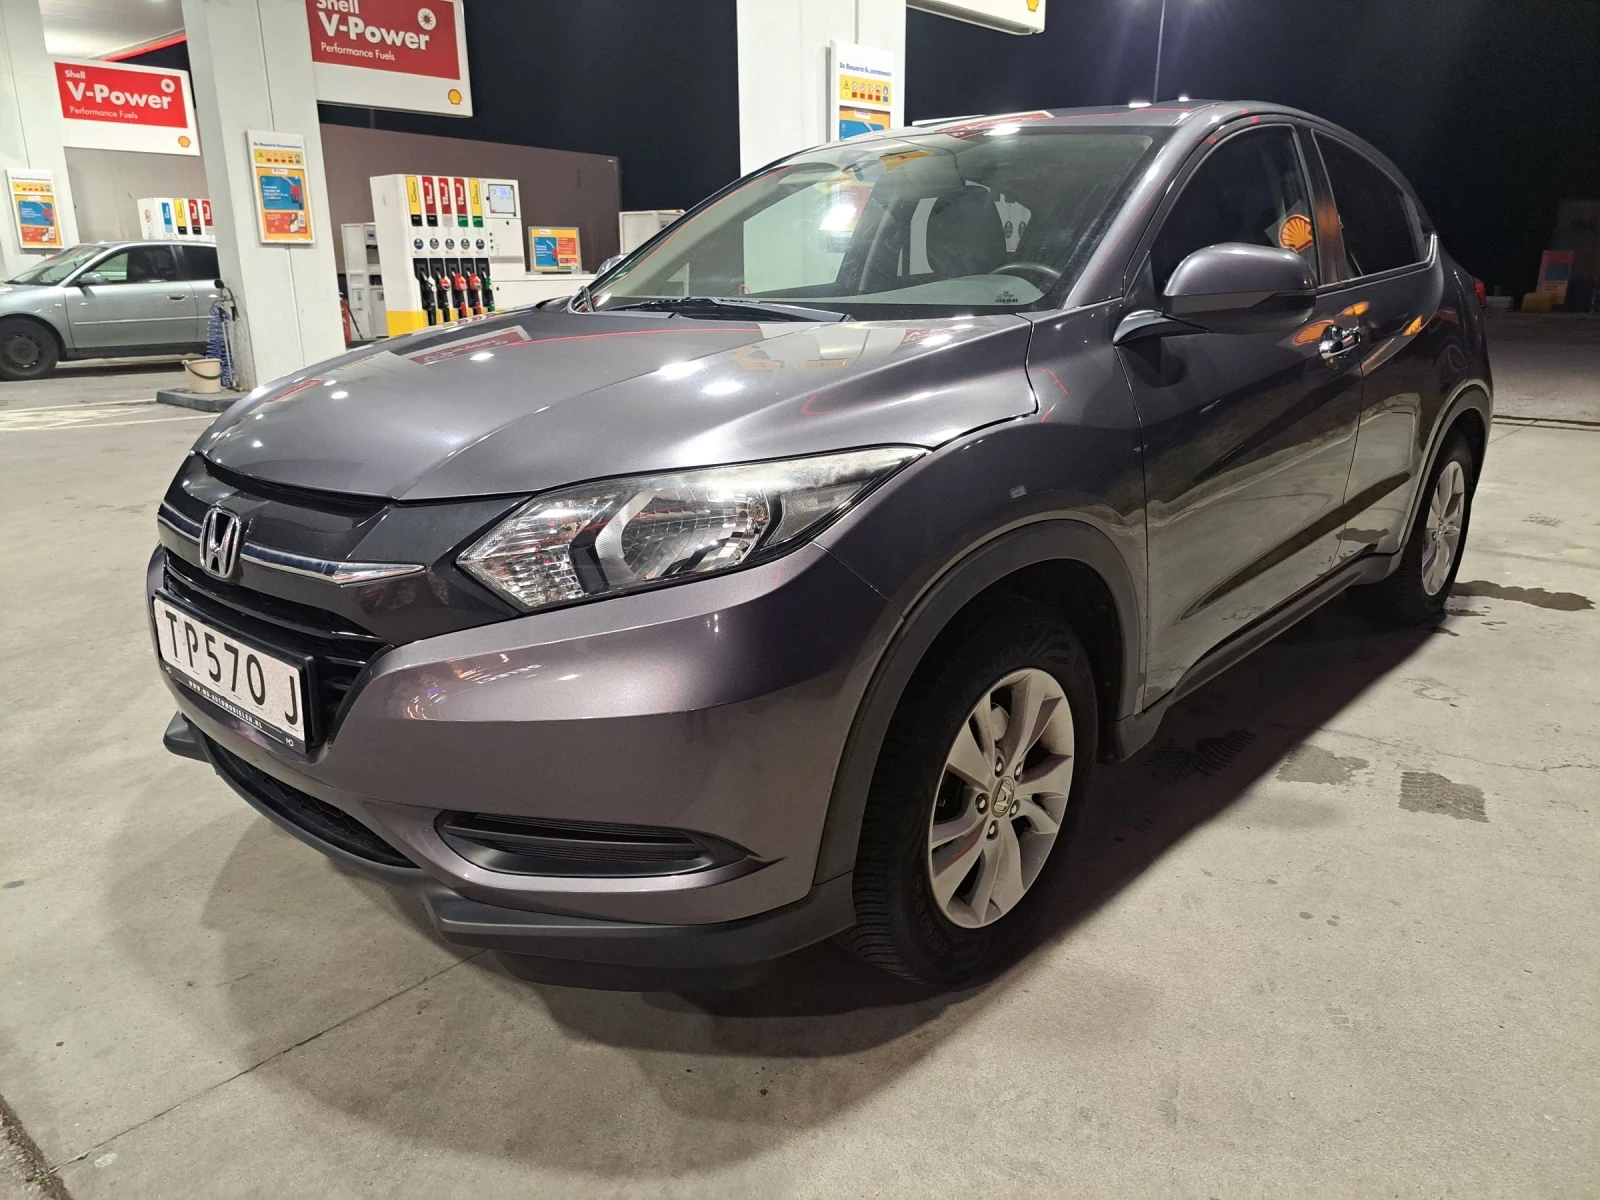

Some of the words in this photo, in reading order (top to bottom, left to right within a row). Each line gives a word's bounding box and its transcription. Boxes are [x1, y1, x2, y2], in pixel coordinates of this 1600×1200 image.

[316, 0, 359, 14] Shell
[318, 11, 430, 50] V-Power
[320, 41, 373, 58] Performance
[375, 50, 396, 61] Fuels
[64, 69, 86, 79] Shell
[65, 80, 172, 109] V-Power
[69, 106, 118, 118] Performance
[119, 110, 138, 119] Fuels
[284, 675, 298, 726] J
